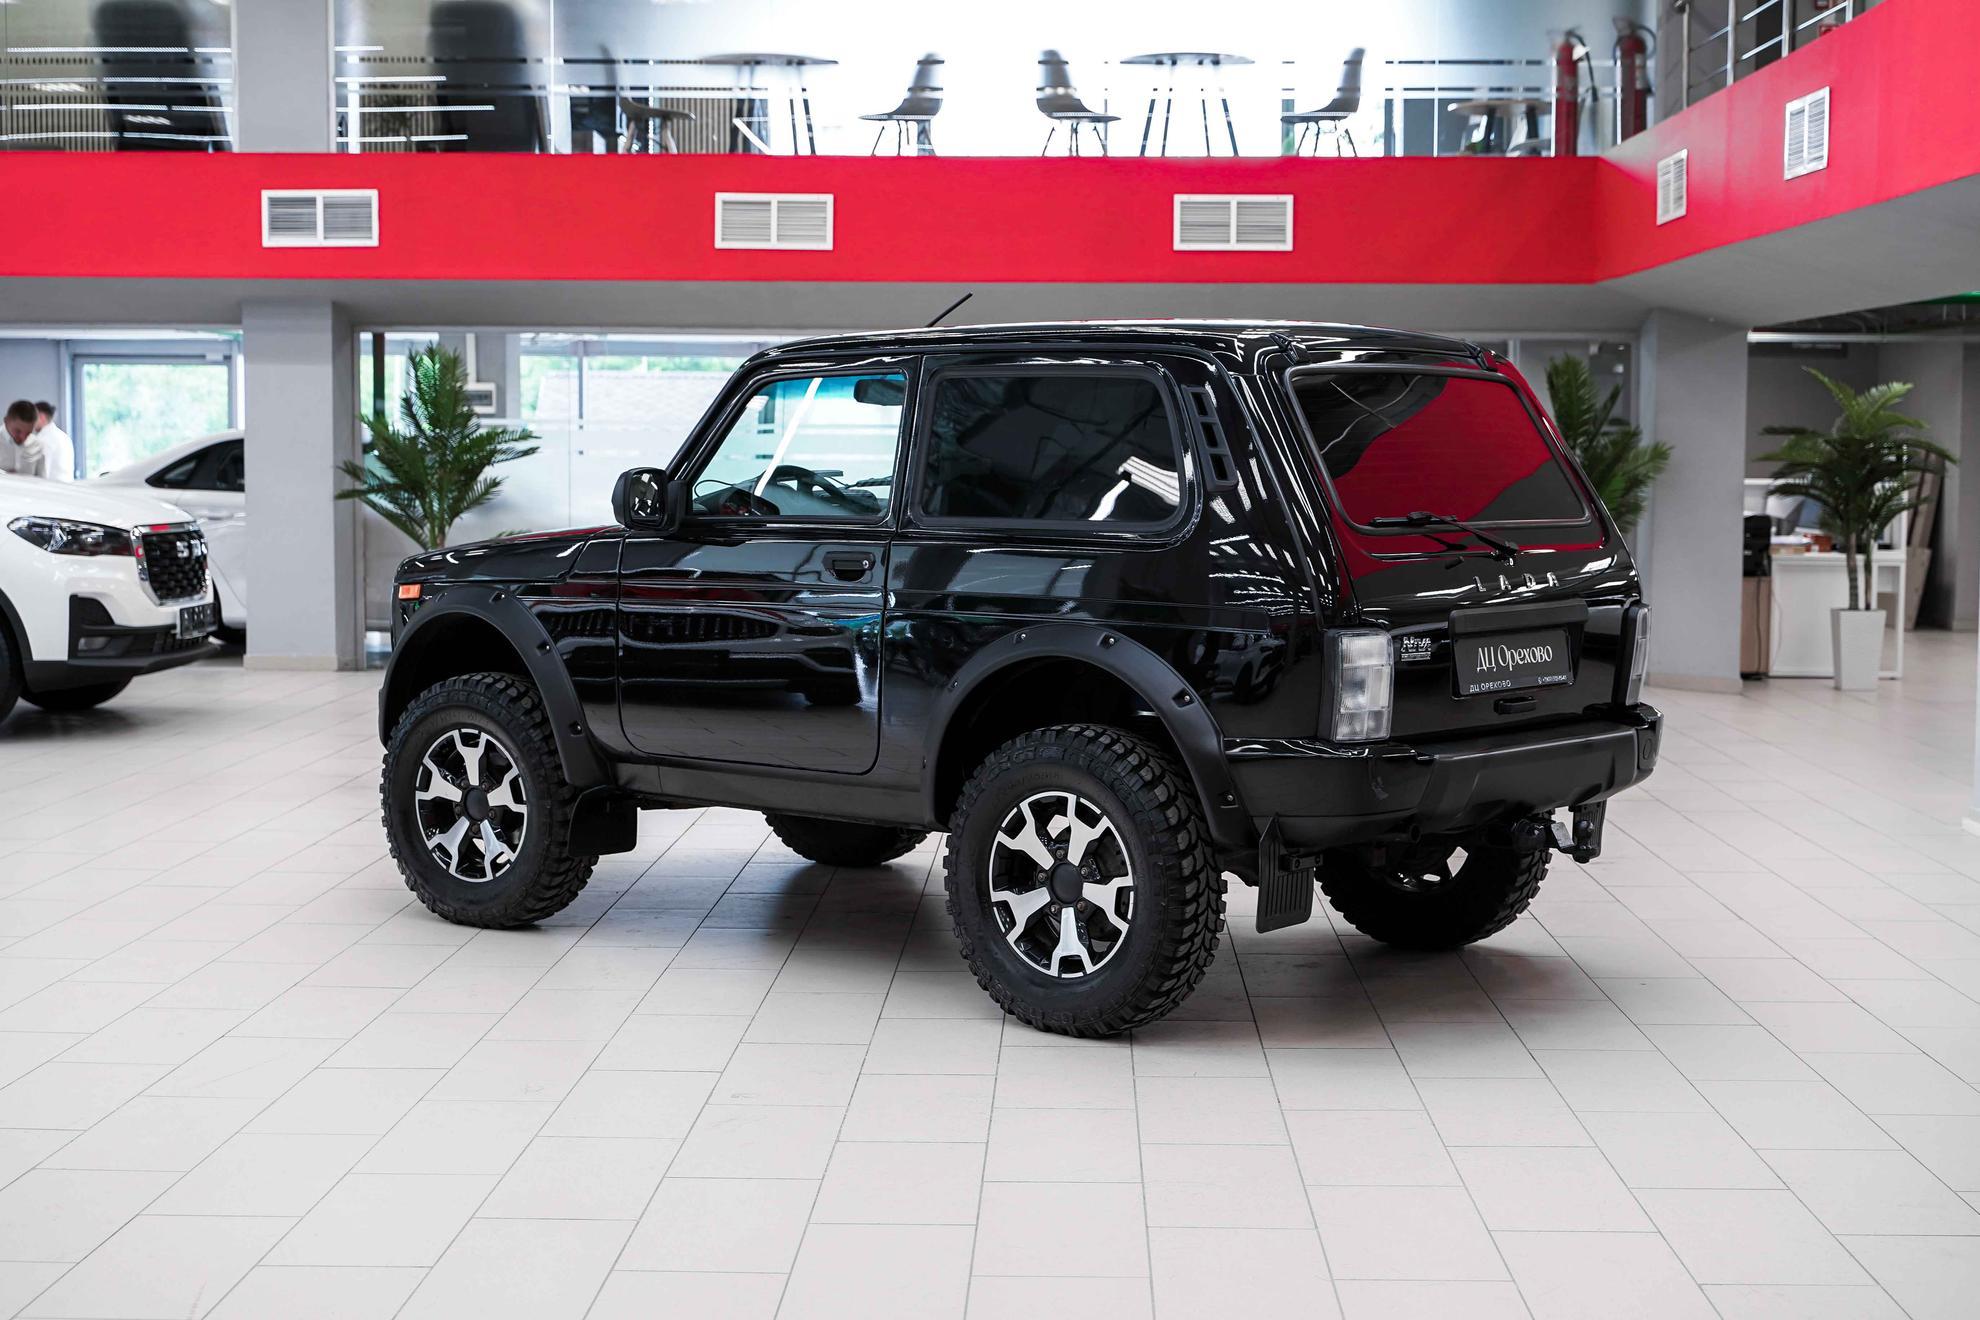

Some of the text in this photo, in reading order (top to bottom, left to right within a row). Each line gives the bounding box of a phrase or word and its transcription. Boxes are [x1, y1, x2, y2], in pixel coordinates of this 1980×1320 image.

[1473, 572, 1559, 592] LADA
[1477, 644, 1553, 673] ДЦ Орехово
[1480, 680, 1511, 690] ОРЕХОВО
